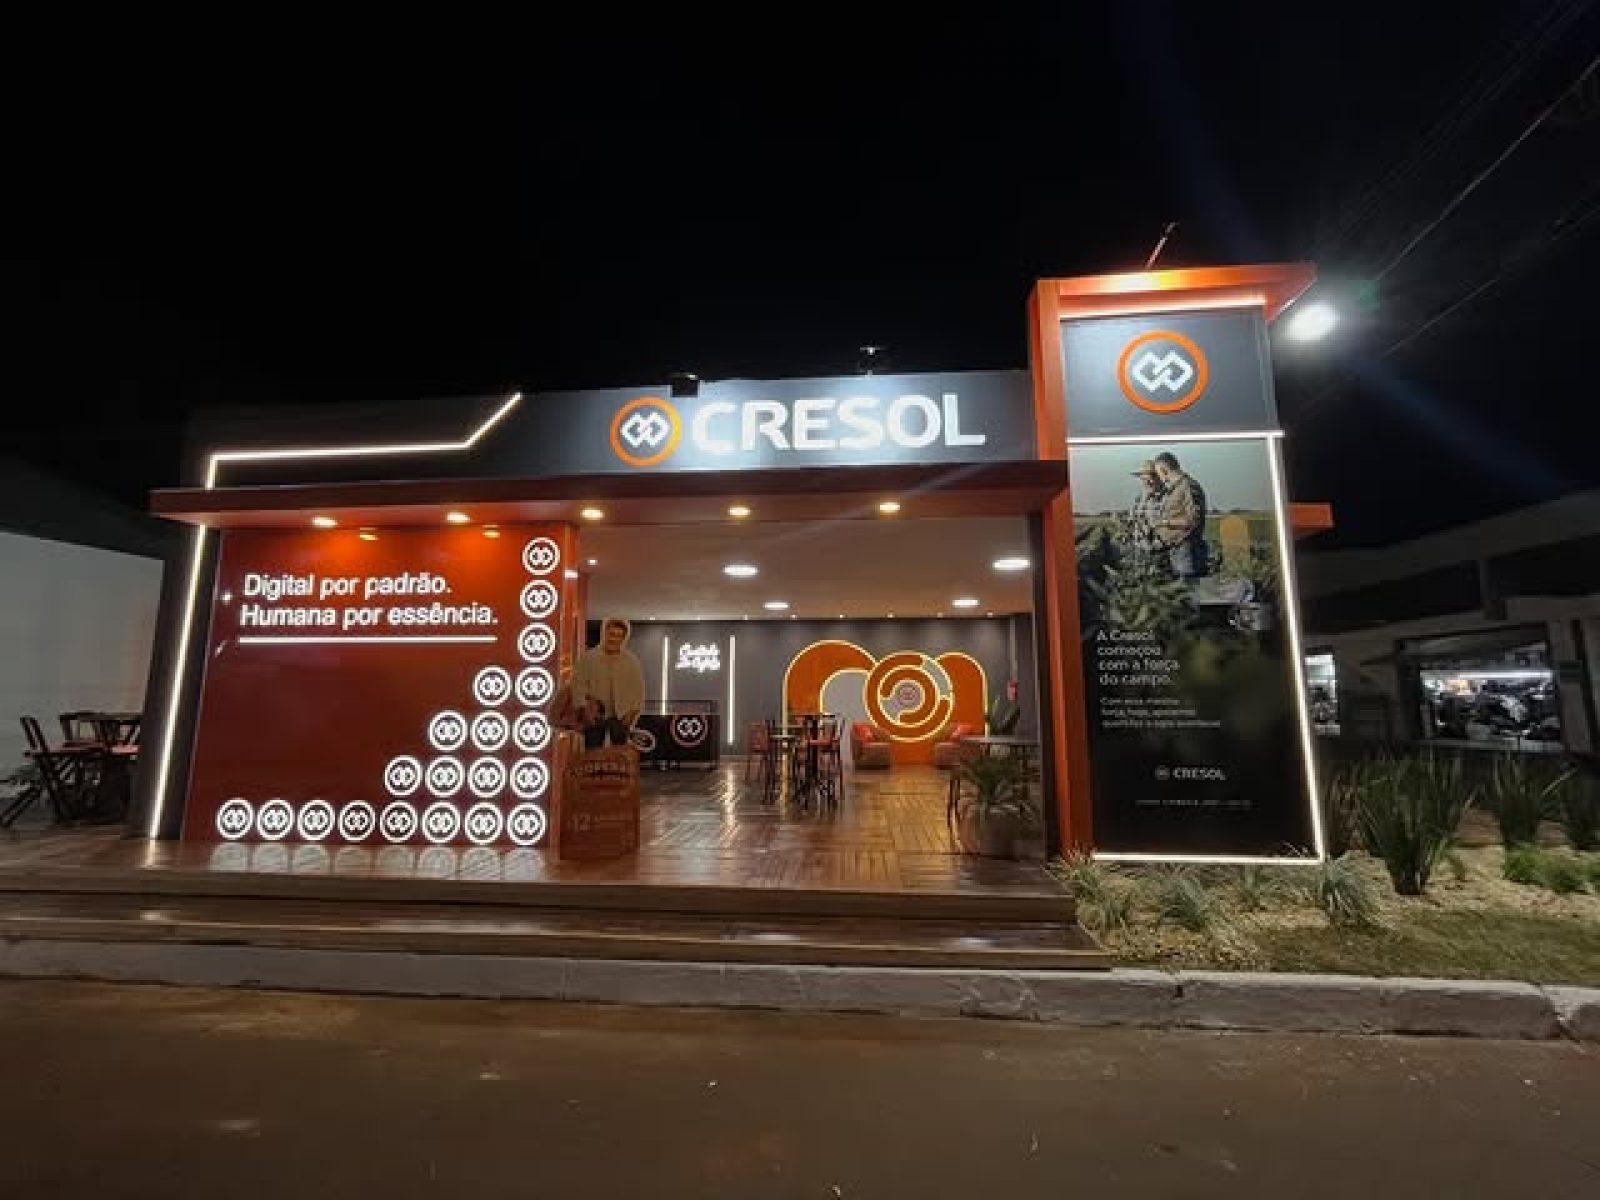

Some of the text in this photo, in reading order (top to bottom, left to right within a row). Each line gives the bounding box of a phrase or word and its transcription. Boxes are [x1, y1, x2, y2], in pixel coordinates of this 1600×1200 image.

[692, 393, 986, 454] CRESOL
[244, 572, 453, 600] Digital por padrão.
[239, 601, 499, 630] Humana por essência.
[1097, 646, 1161, 658] começou
[1099, 658, 1181, 673] com a força
[1099, 672, 1176, 688] do campo.
